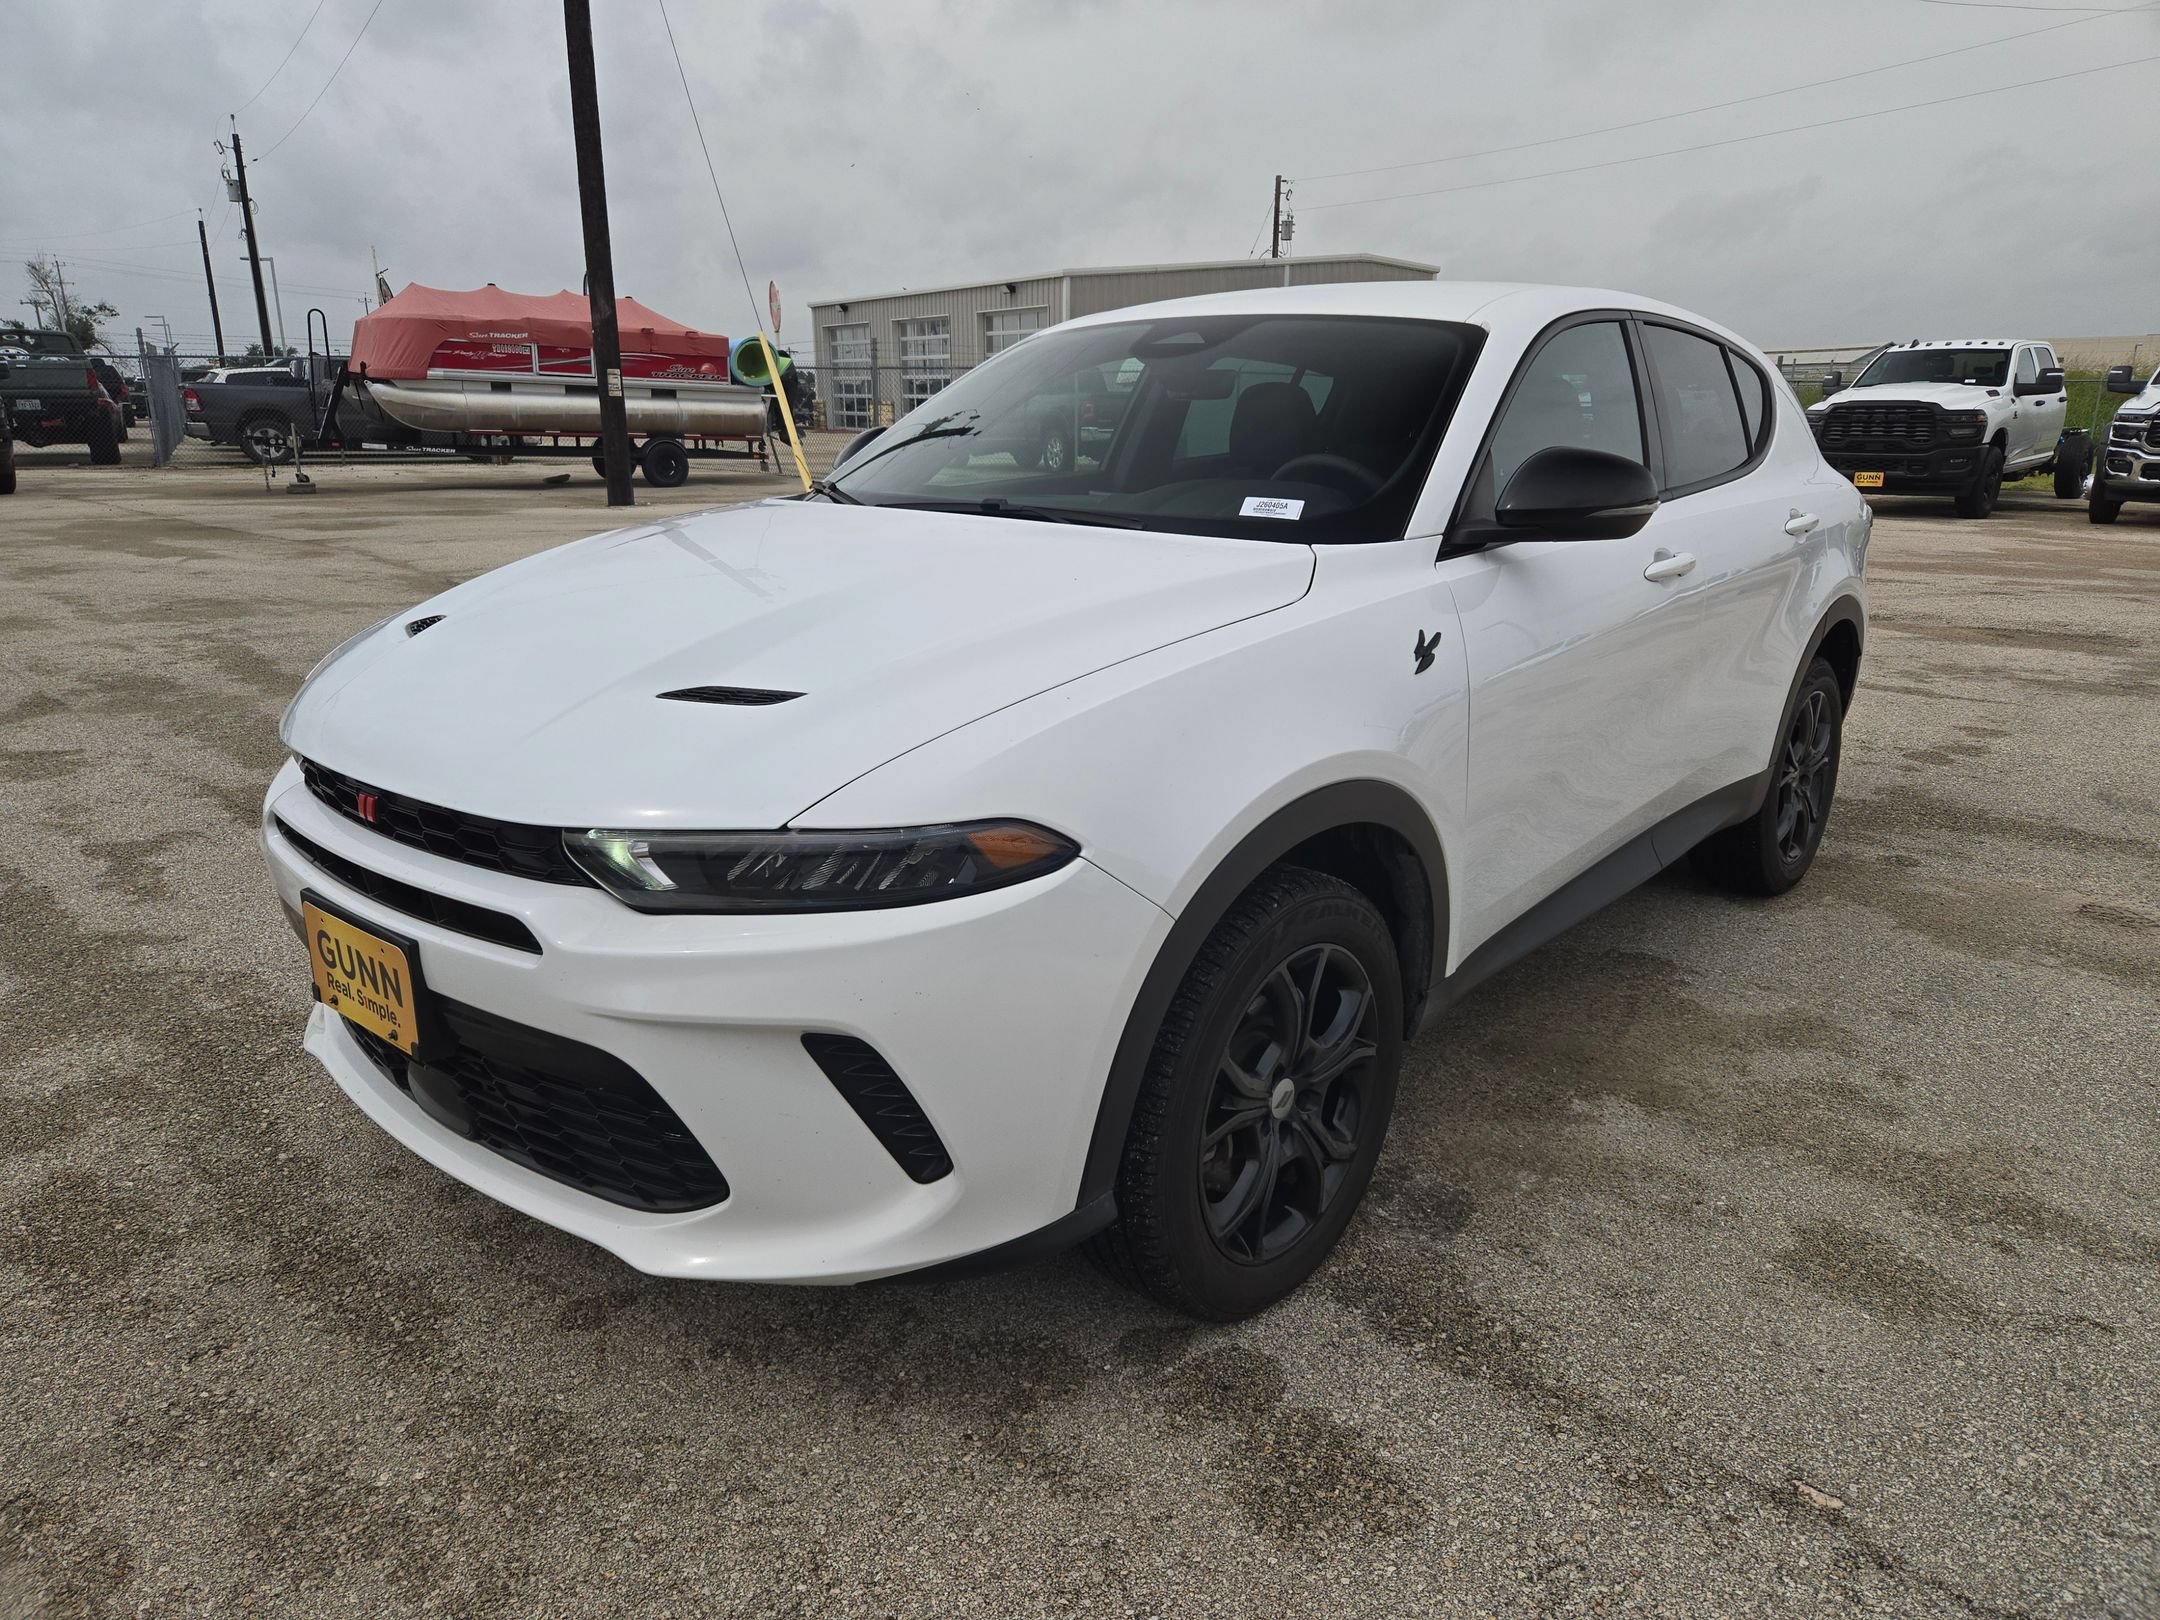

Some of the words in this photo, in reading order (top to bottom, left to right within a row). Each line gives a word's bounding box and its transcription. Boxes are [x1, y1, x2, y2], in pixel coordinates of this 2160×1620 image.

[651, 371, 721, 380] TRACKER
[1856, 473, 1881, 481] GUNN
[317, 929, 404, 1009] GUNN
[326, 971, 355, 1002] Real.
